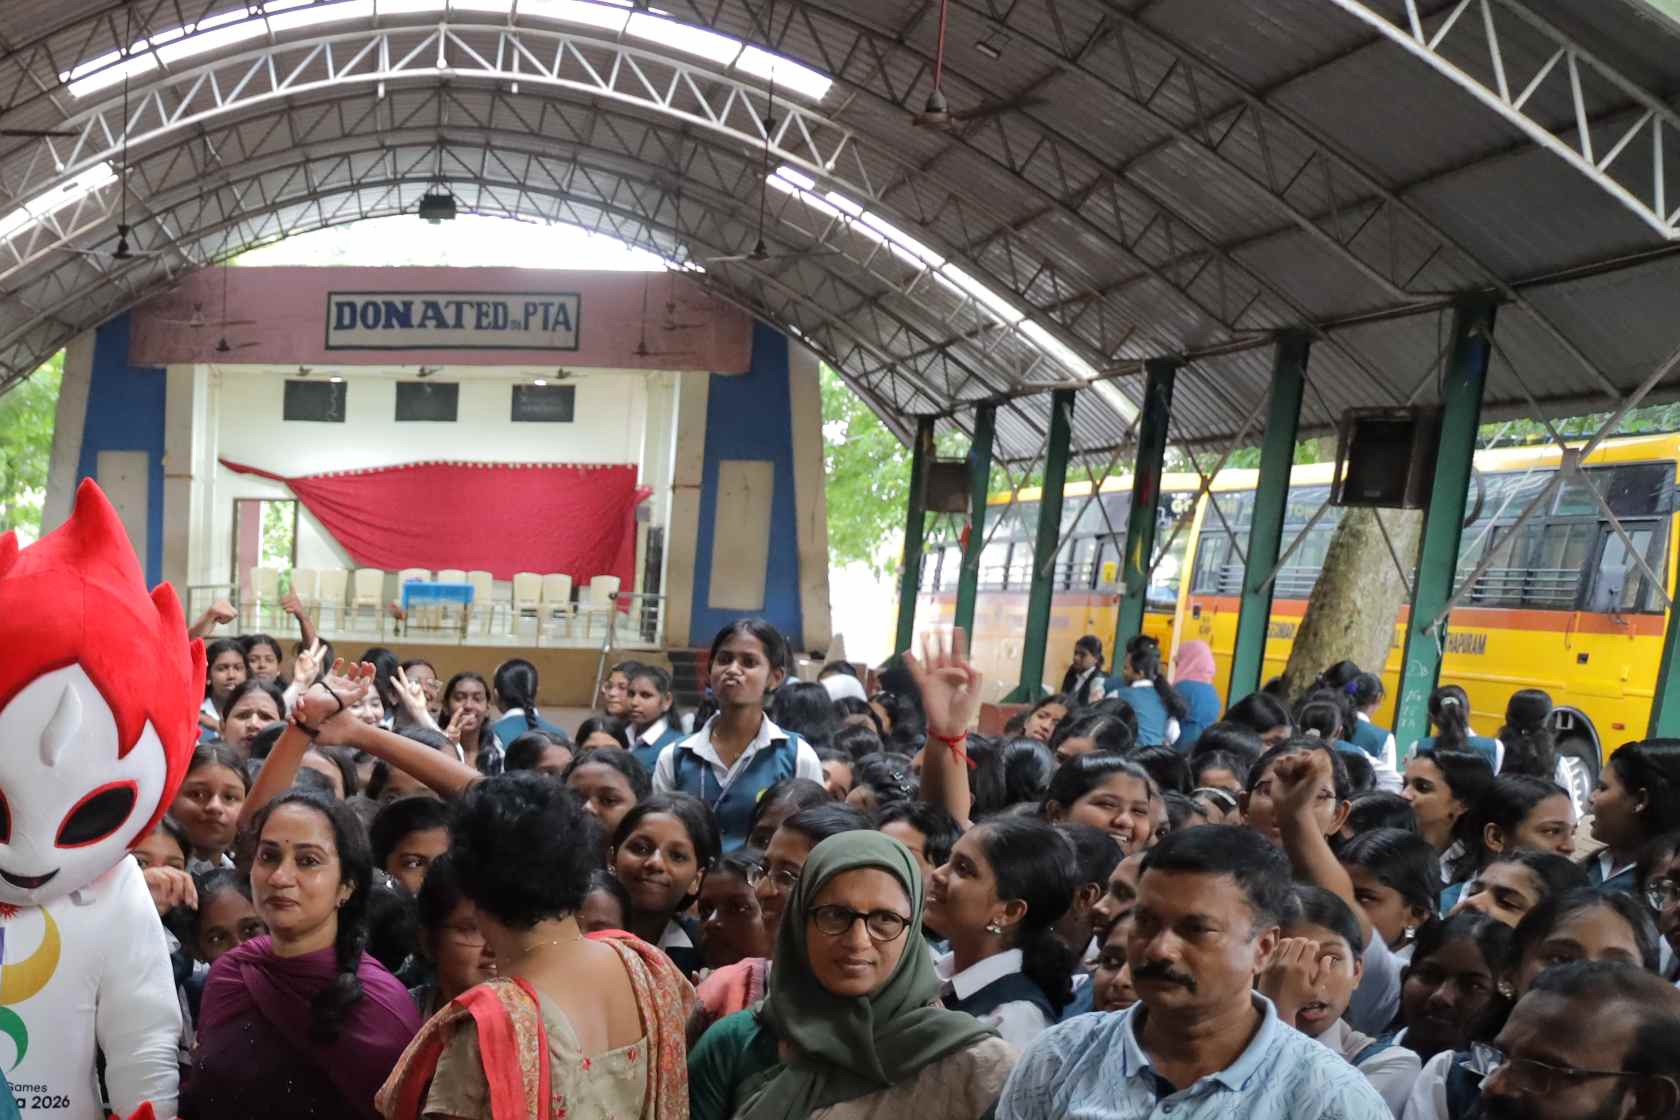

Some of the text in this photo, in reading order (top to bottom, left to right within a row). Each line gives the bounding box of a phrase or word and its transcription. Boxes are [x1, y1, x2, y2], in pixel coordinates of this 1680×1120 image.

[333, 301, 572, 332] DONATED PTA
[31, 1095, 70, 1109] 2026
